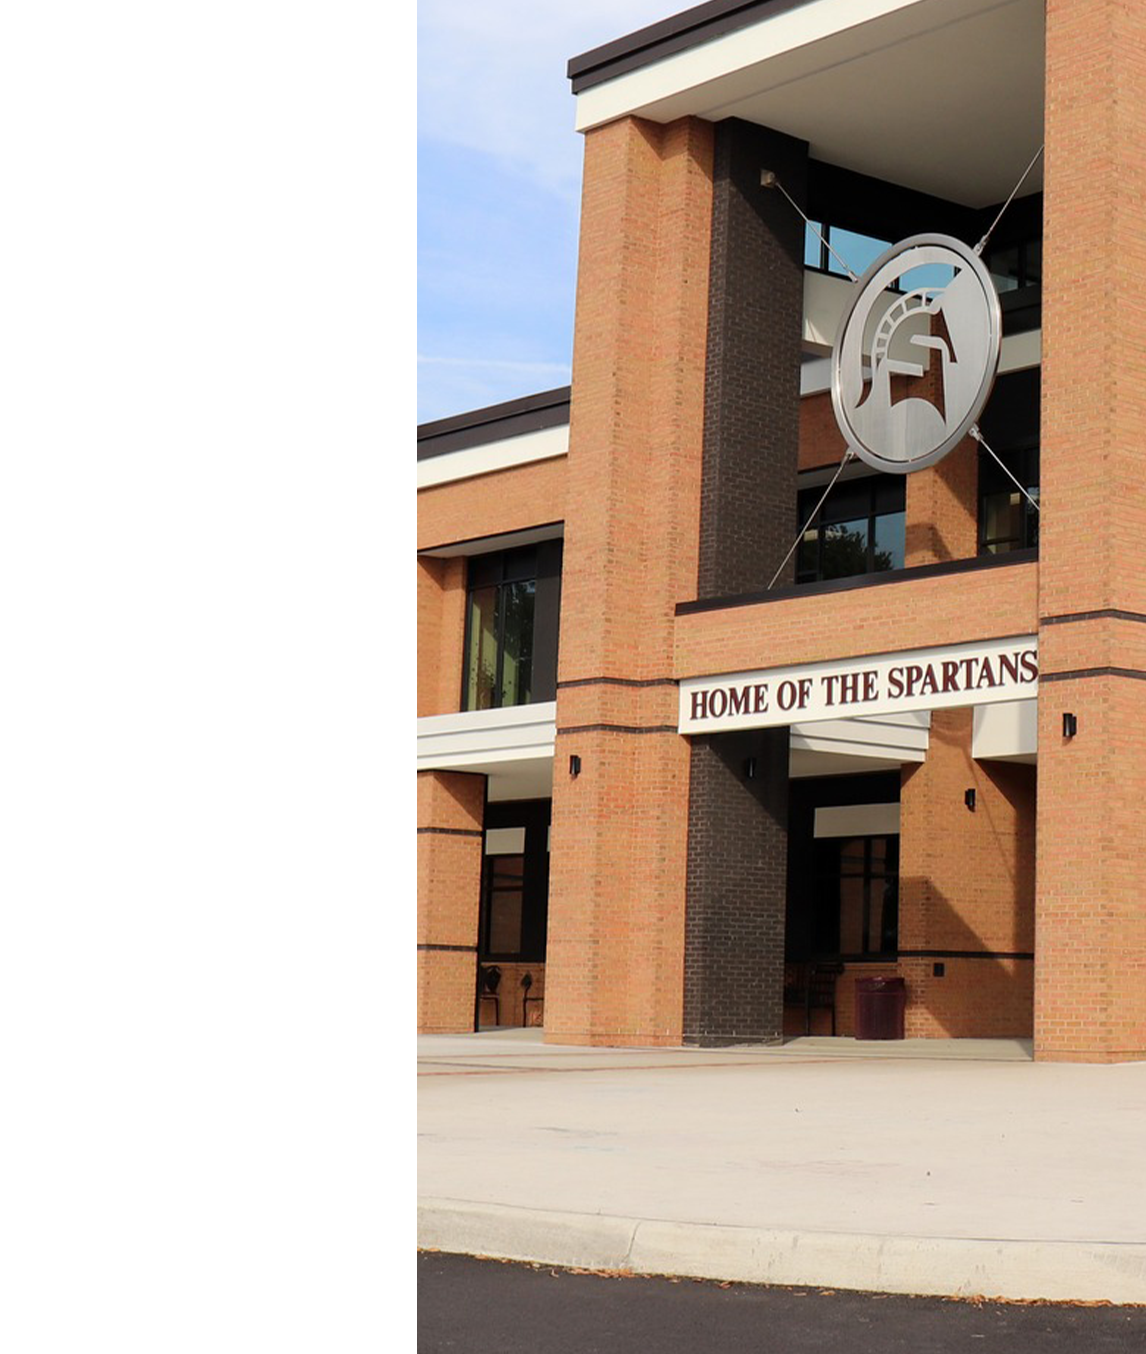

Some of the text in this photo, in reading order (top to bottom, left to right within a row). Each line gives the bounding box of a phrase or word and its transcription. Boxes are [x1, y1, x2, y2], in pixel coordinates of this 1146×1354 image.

[690, 650, 1038, 719] HOME OF THE SPARTANS
